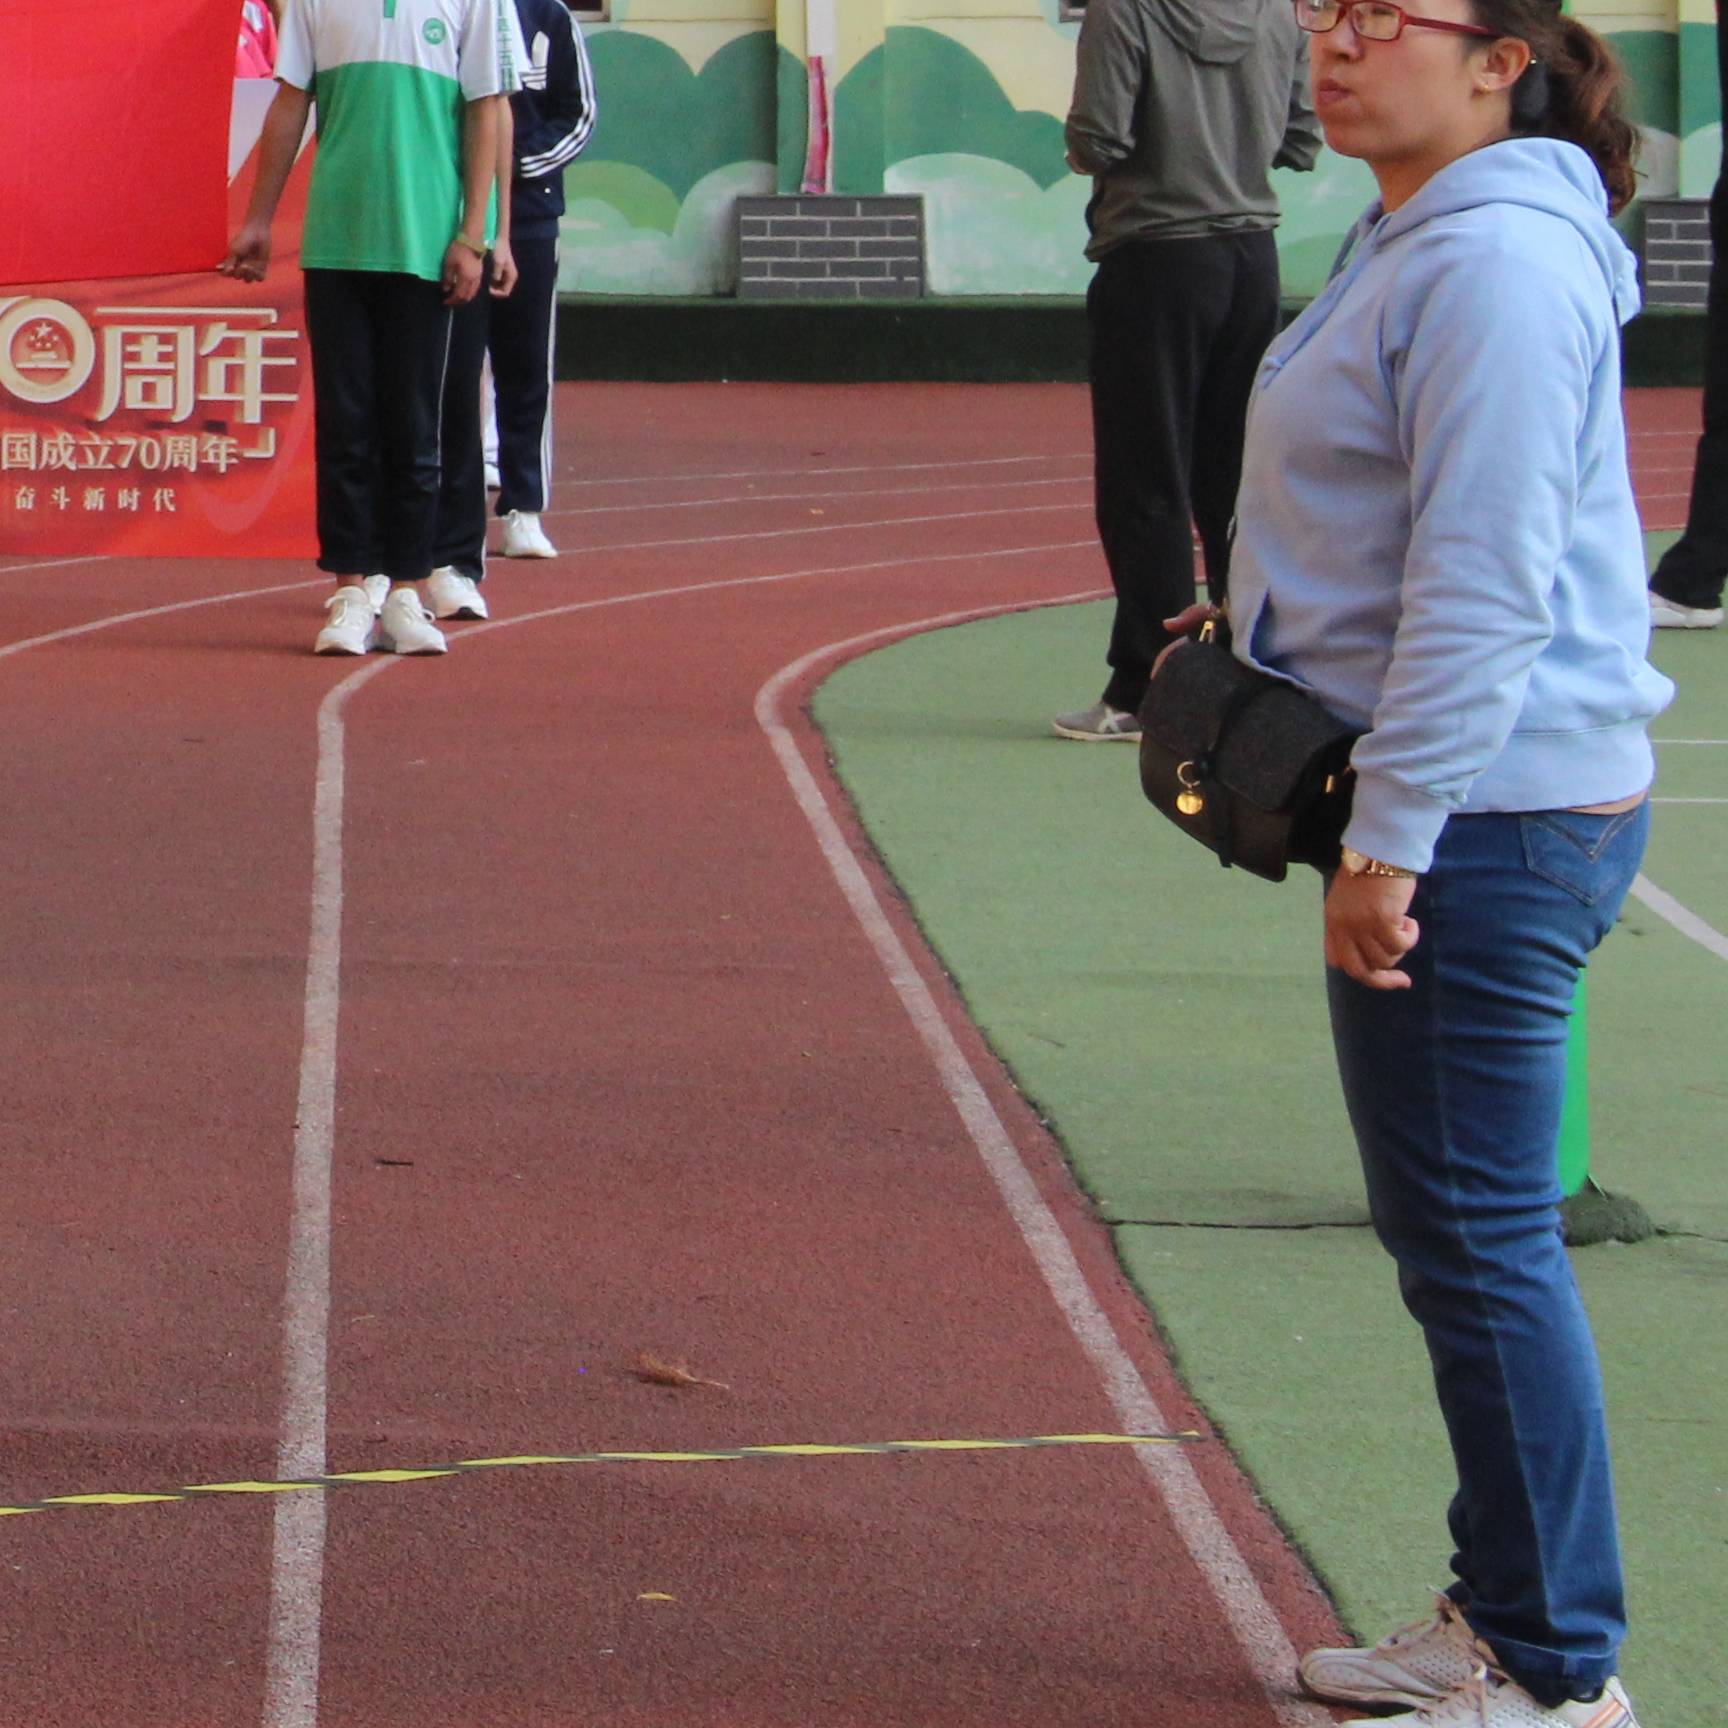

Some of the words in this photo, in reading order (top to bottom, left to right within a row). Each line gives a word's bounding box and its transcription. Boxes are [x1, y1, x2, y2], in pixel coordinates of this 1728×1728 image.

[14, 484, 177, 512] 奋斗新时代
